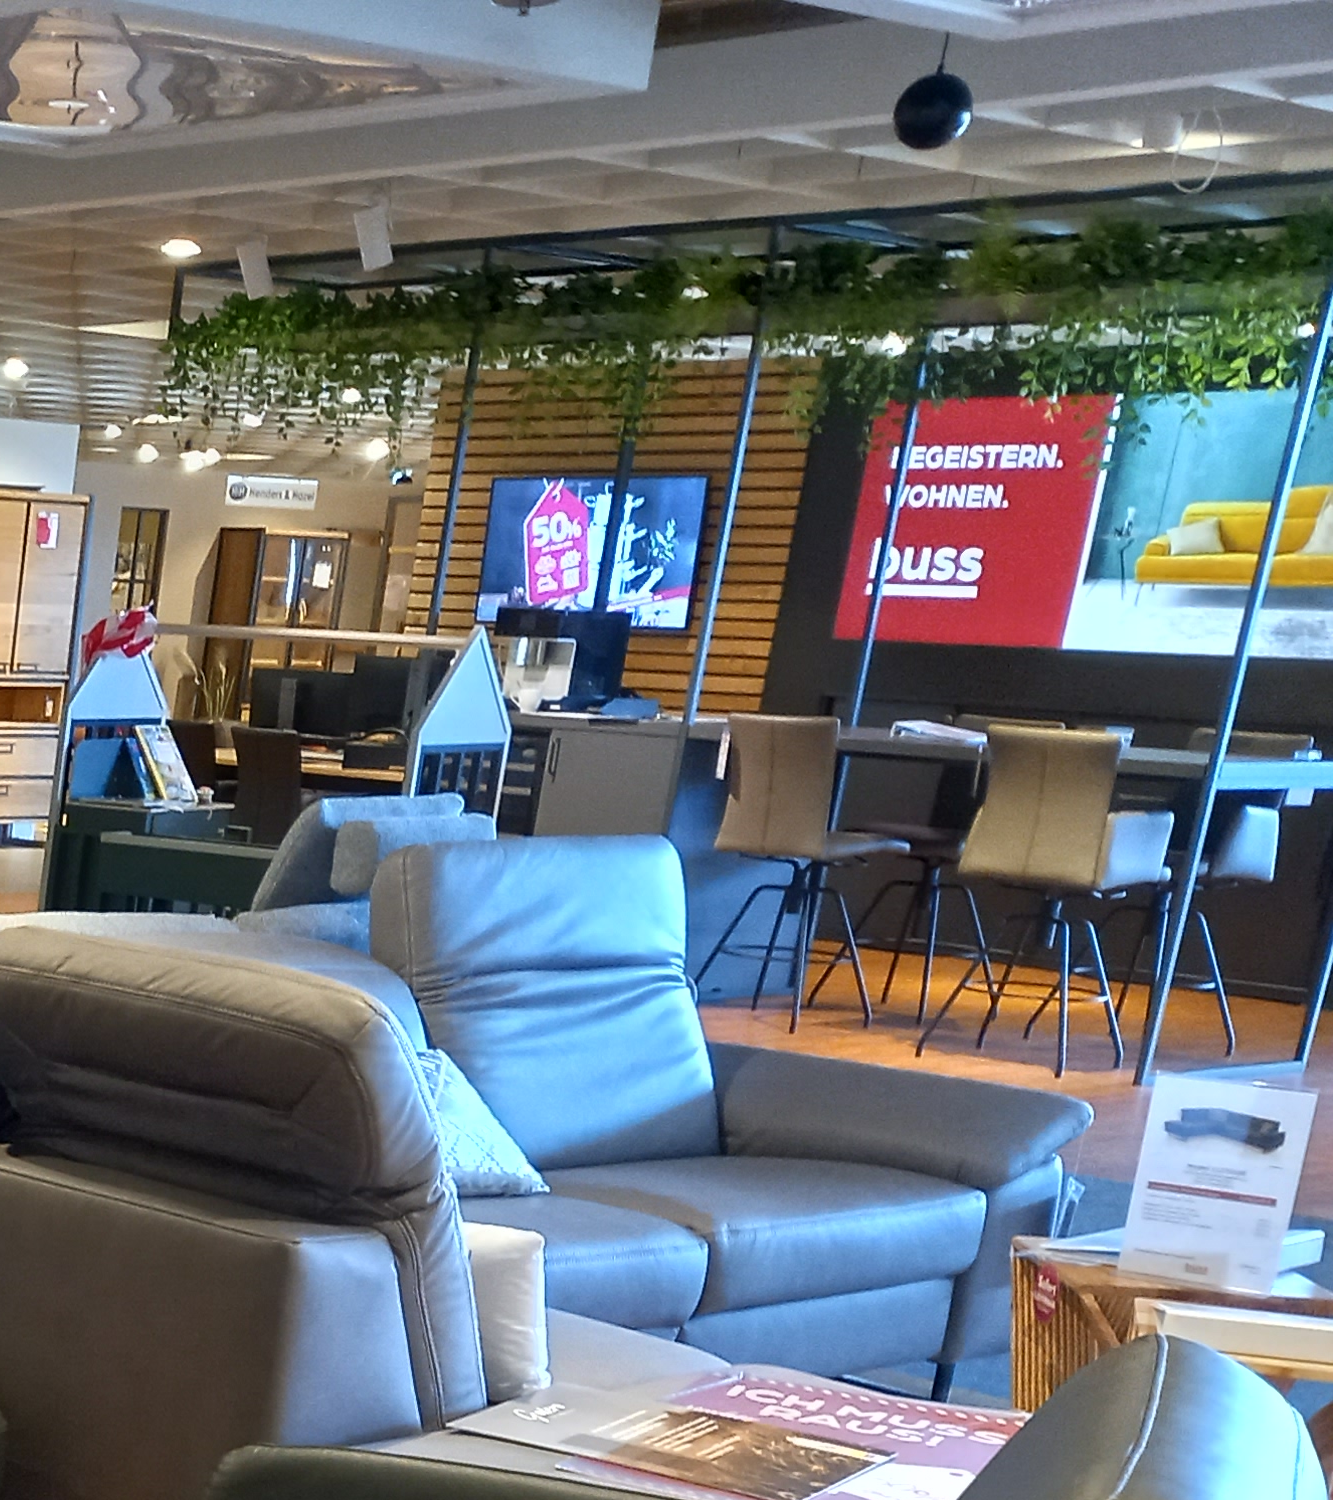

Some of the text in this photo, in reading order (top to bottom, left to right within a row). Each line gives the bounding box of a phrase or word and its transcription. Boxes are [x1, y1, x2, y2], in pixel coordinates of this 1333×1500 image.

[532, 511, 582, 548] 50%
[727, 1384, 1010, 1446] ICH MUSS
[759, 1404, 945, 1448] RAUS!
